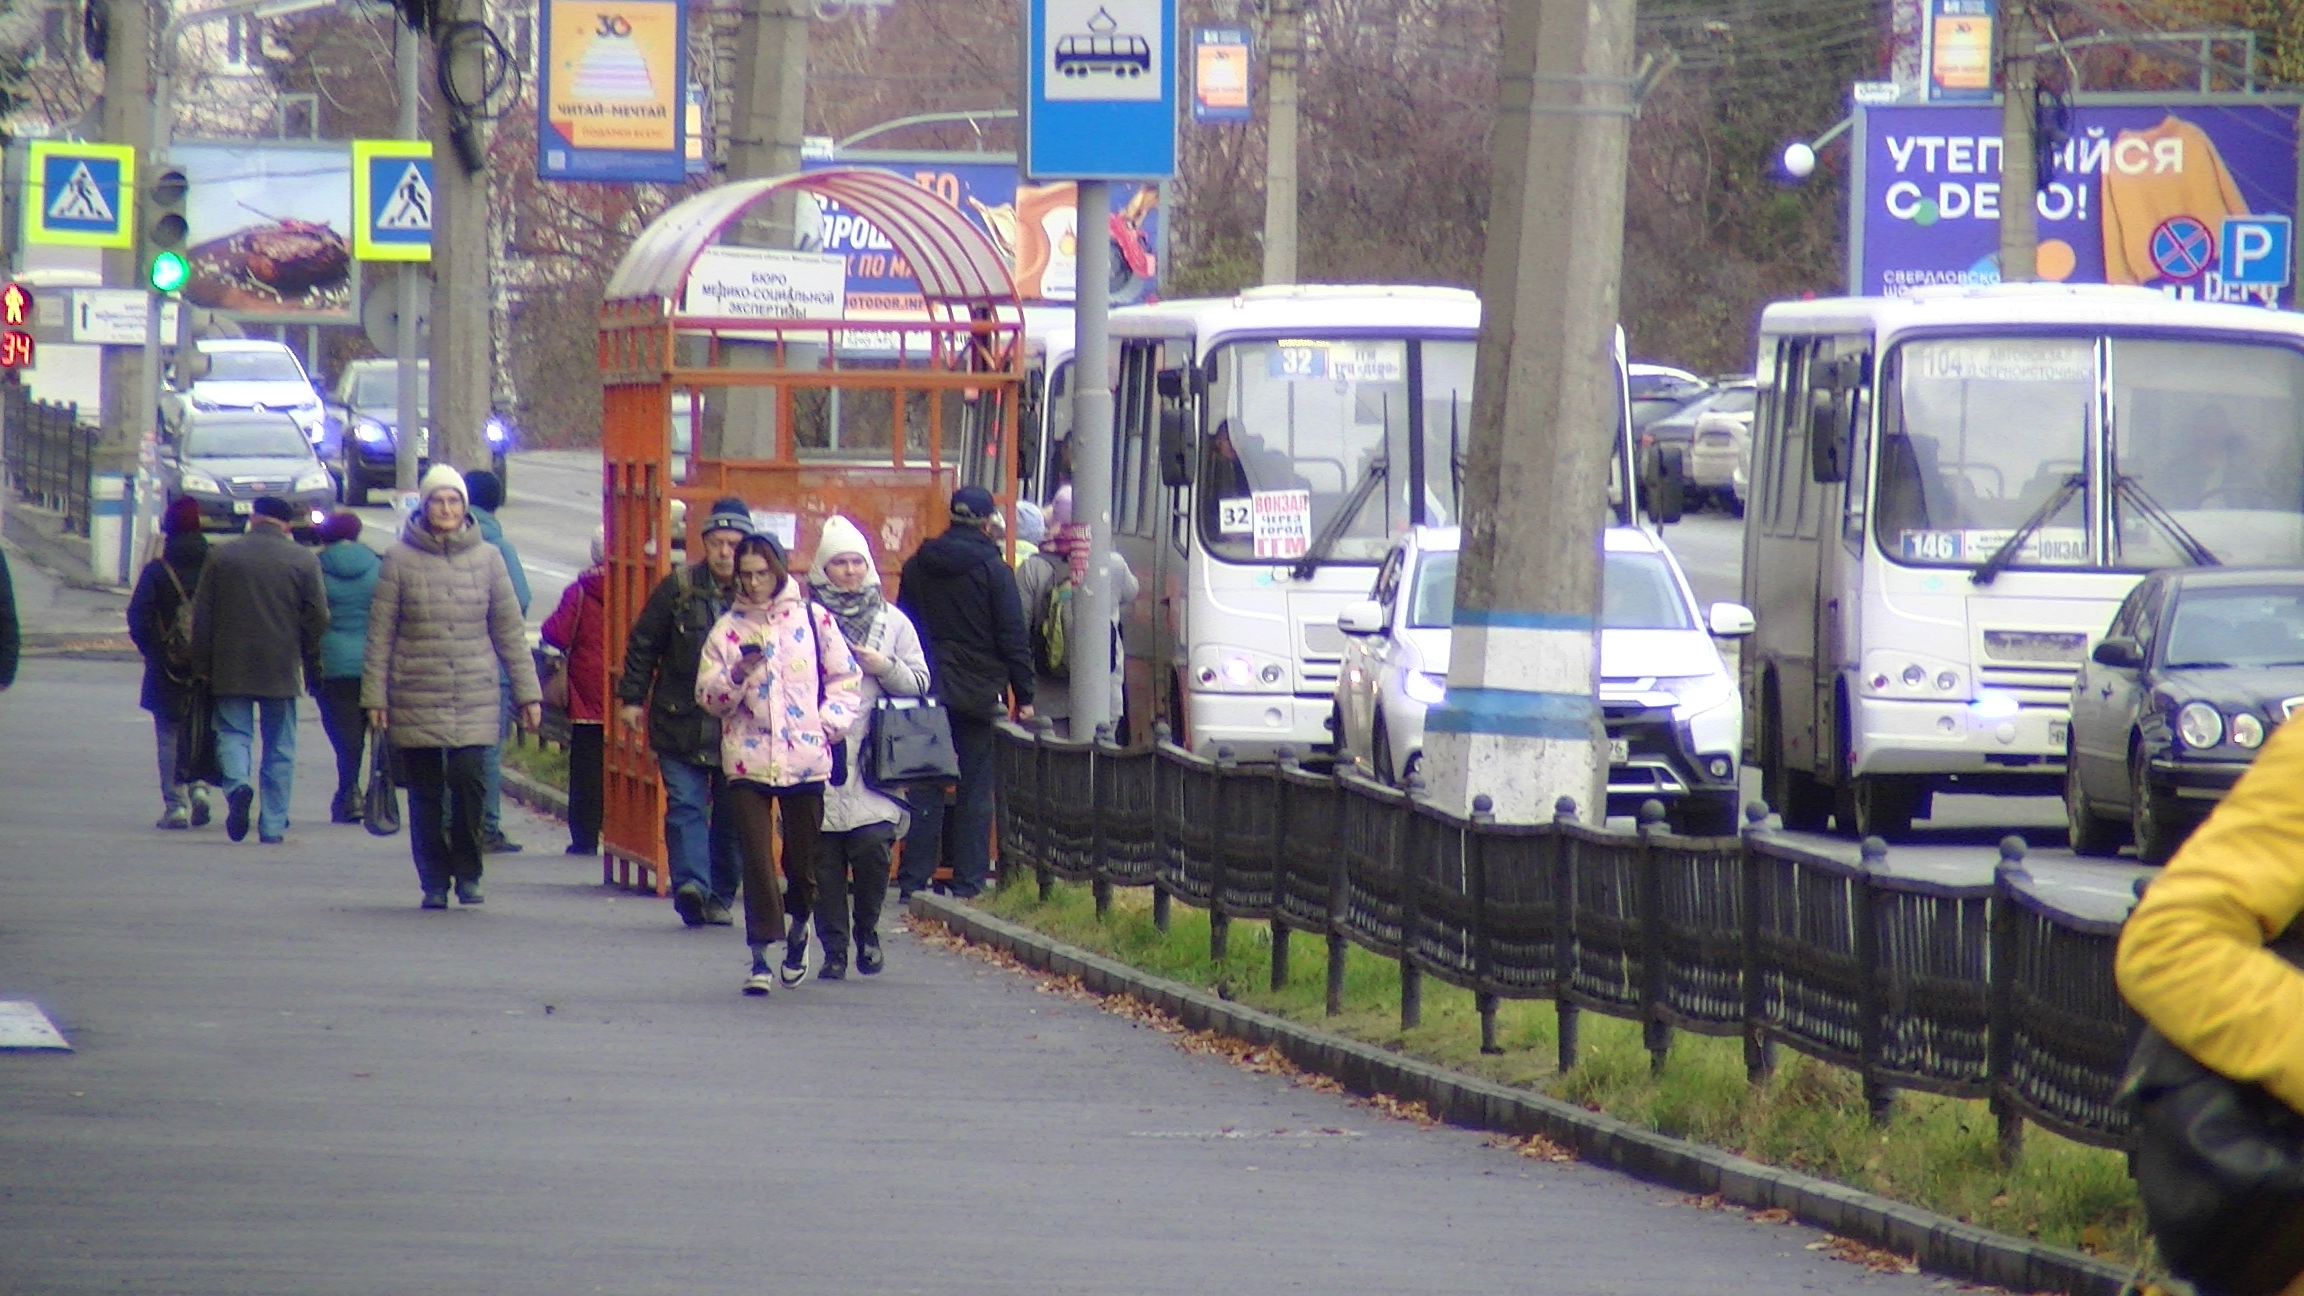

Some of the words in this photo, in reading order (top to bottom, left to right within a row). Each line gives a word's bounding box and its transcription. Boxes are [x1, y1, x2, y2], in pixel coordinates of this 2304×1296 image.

[595, 15, 632, 37] 30
[1939, 182, 2087, 220] DEO!
[2234, 225, 2273, 278] P
[751, 272, 787, 287] БЮРО
[1883, 269, 1999, 285] СВЕРДЛОВСКО
[702, 282, 835, 305] МЕДИКО-СОЦИАЛЬНОЙ
[846, 296, 925, 312] OTODOR.INF
[728, 302, 807, 319] ЭКСПЕРТИЗЫ
[1, 332, 31, 367] 34
[1282, 349, 1313, 374] 32
[1255, 495, 1308, 514] ВОКЗАЛ
[1224, 507, 1249, 526] 32
[1257, 537, 1306, 557] ГГМ
[1911, 534, 1954, 559] 146
